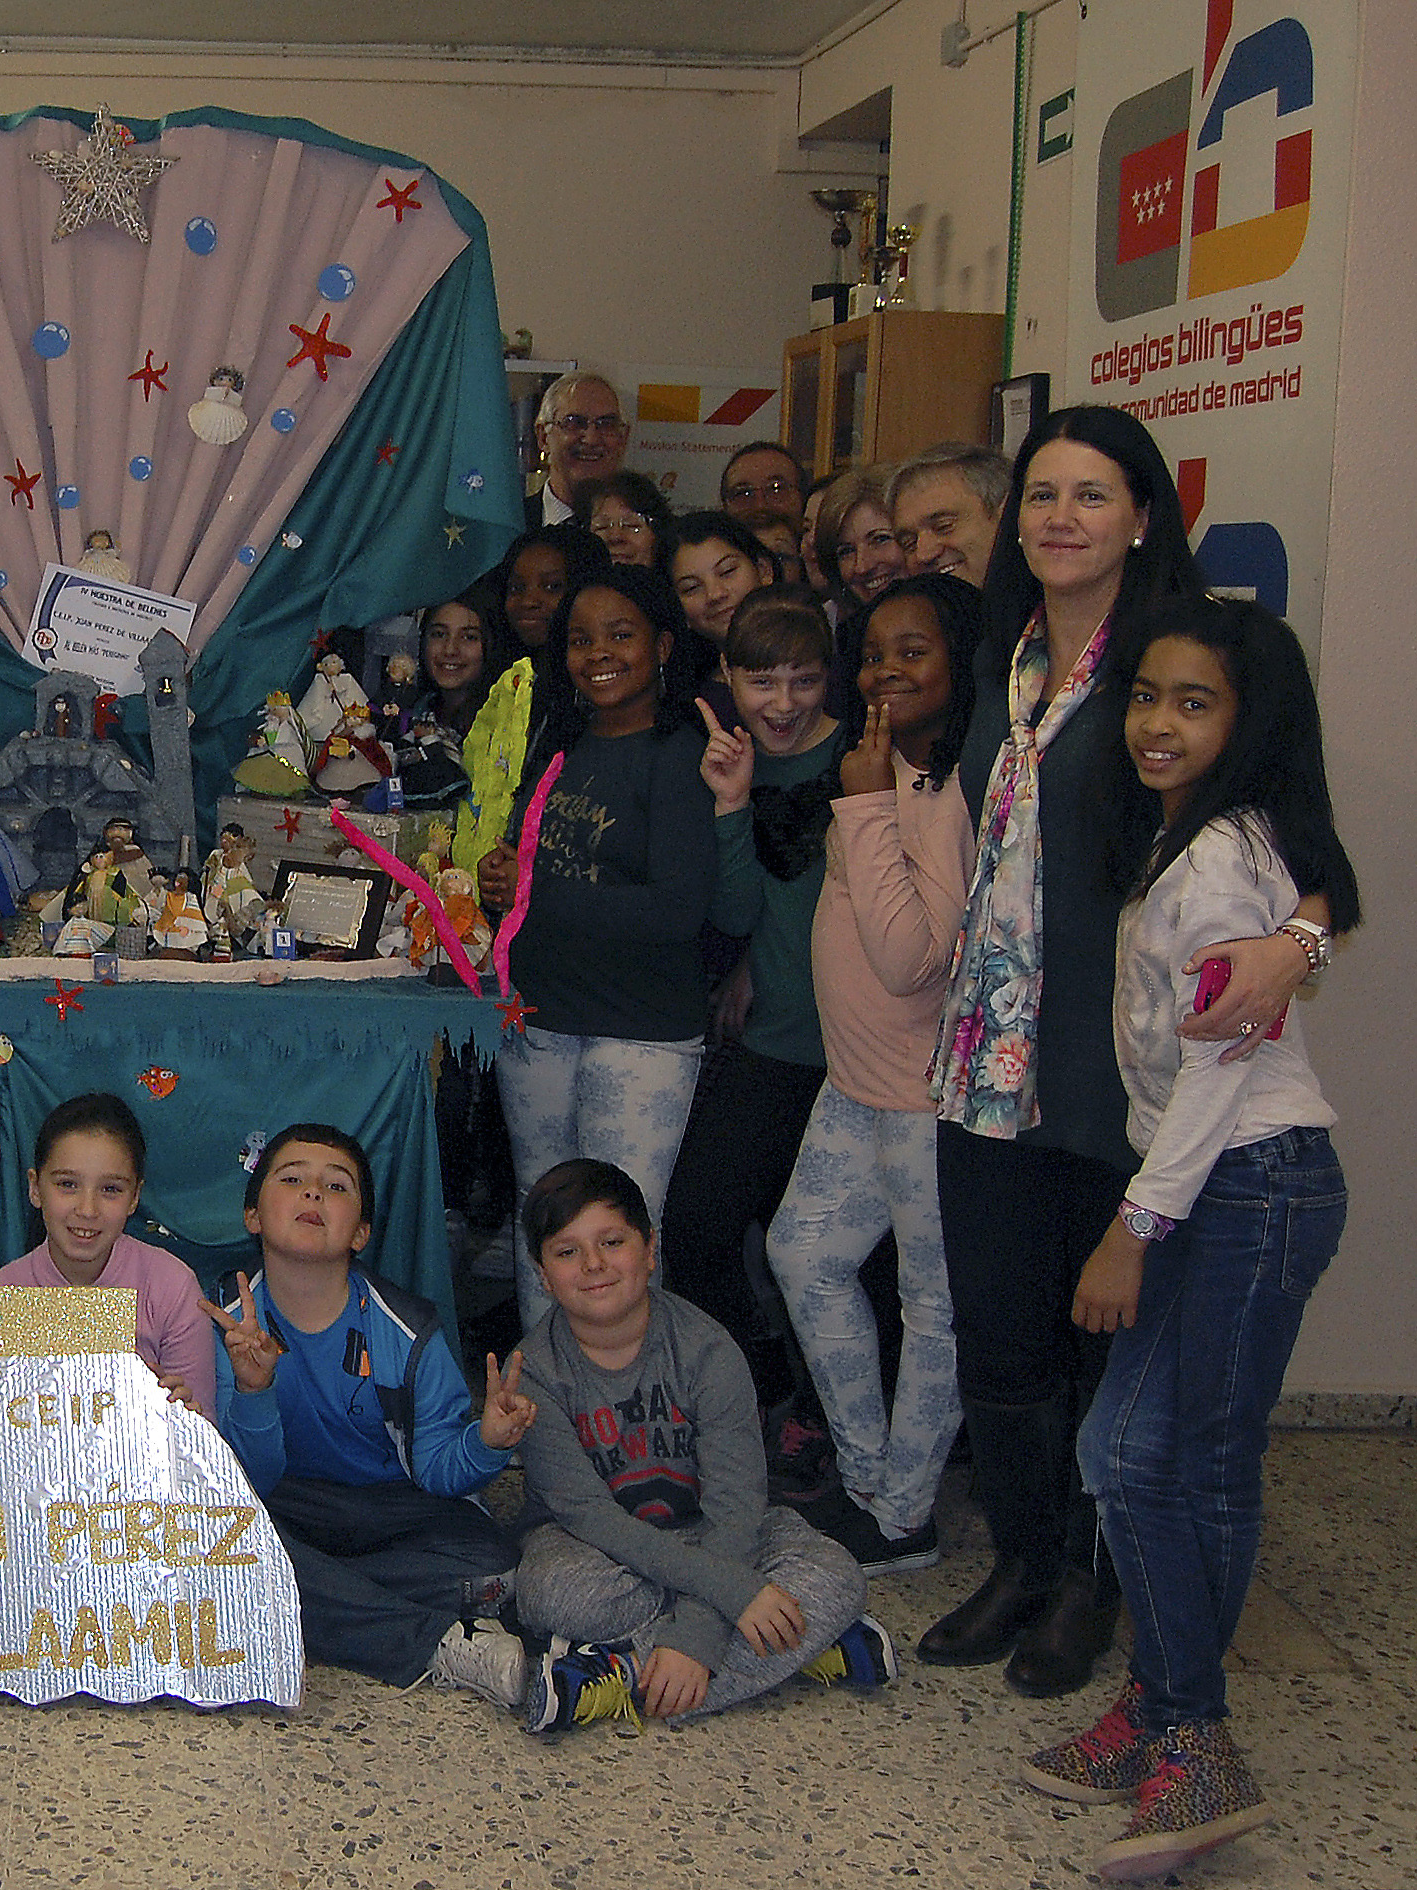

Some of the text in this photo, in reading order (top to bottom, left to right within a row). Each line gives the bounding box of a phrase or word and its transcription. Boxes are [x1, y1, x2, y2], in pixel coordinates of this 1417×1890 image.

[1090, 303, 1304, 386] colegios bilingües
[1203, 381, 1226, 411] de
[1230, 365, 1301, 407] madrid
[6, 1391, 116, 1429] CEIP
[47, 1482, 259, 1567] PÉREZ
